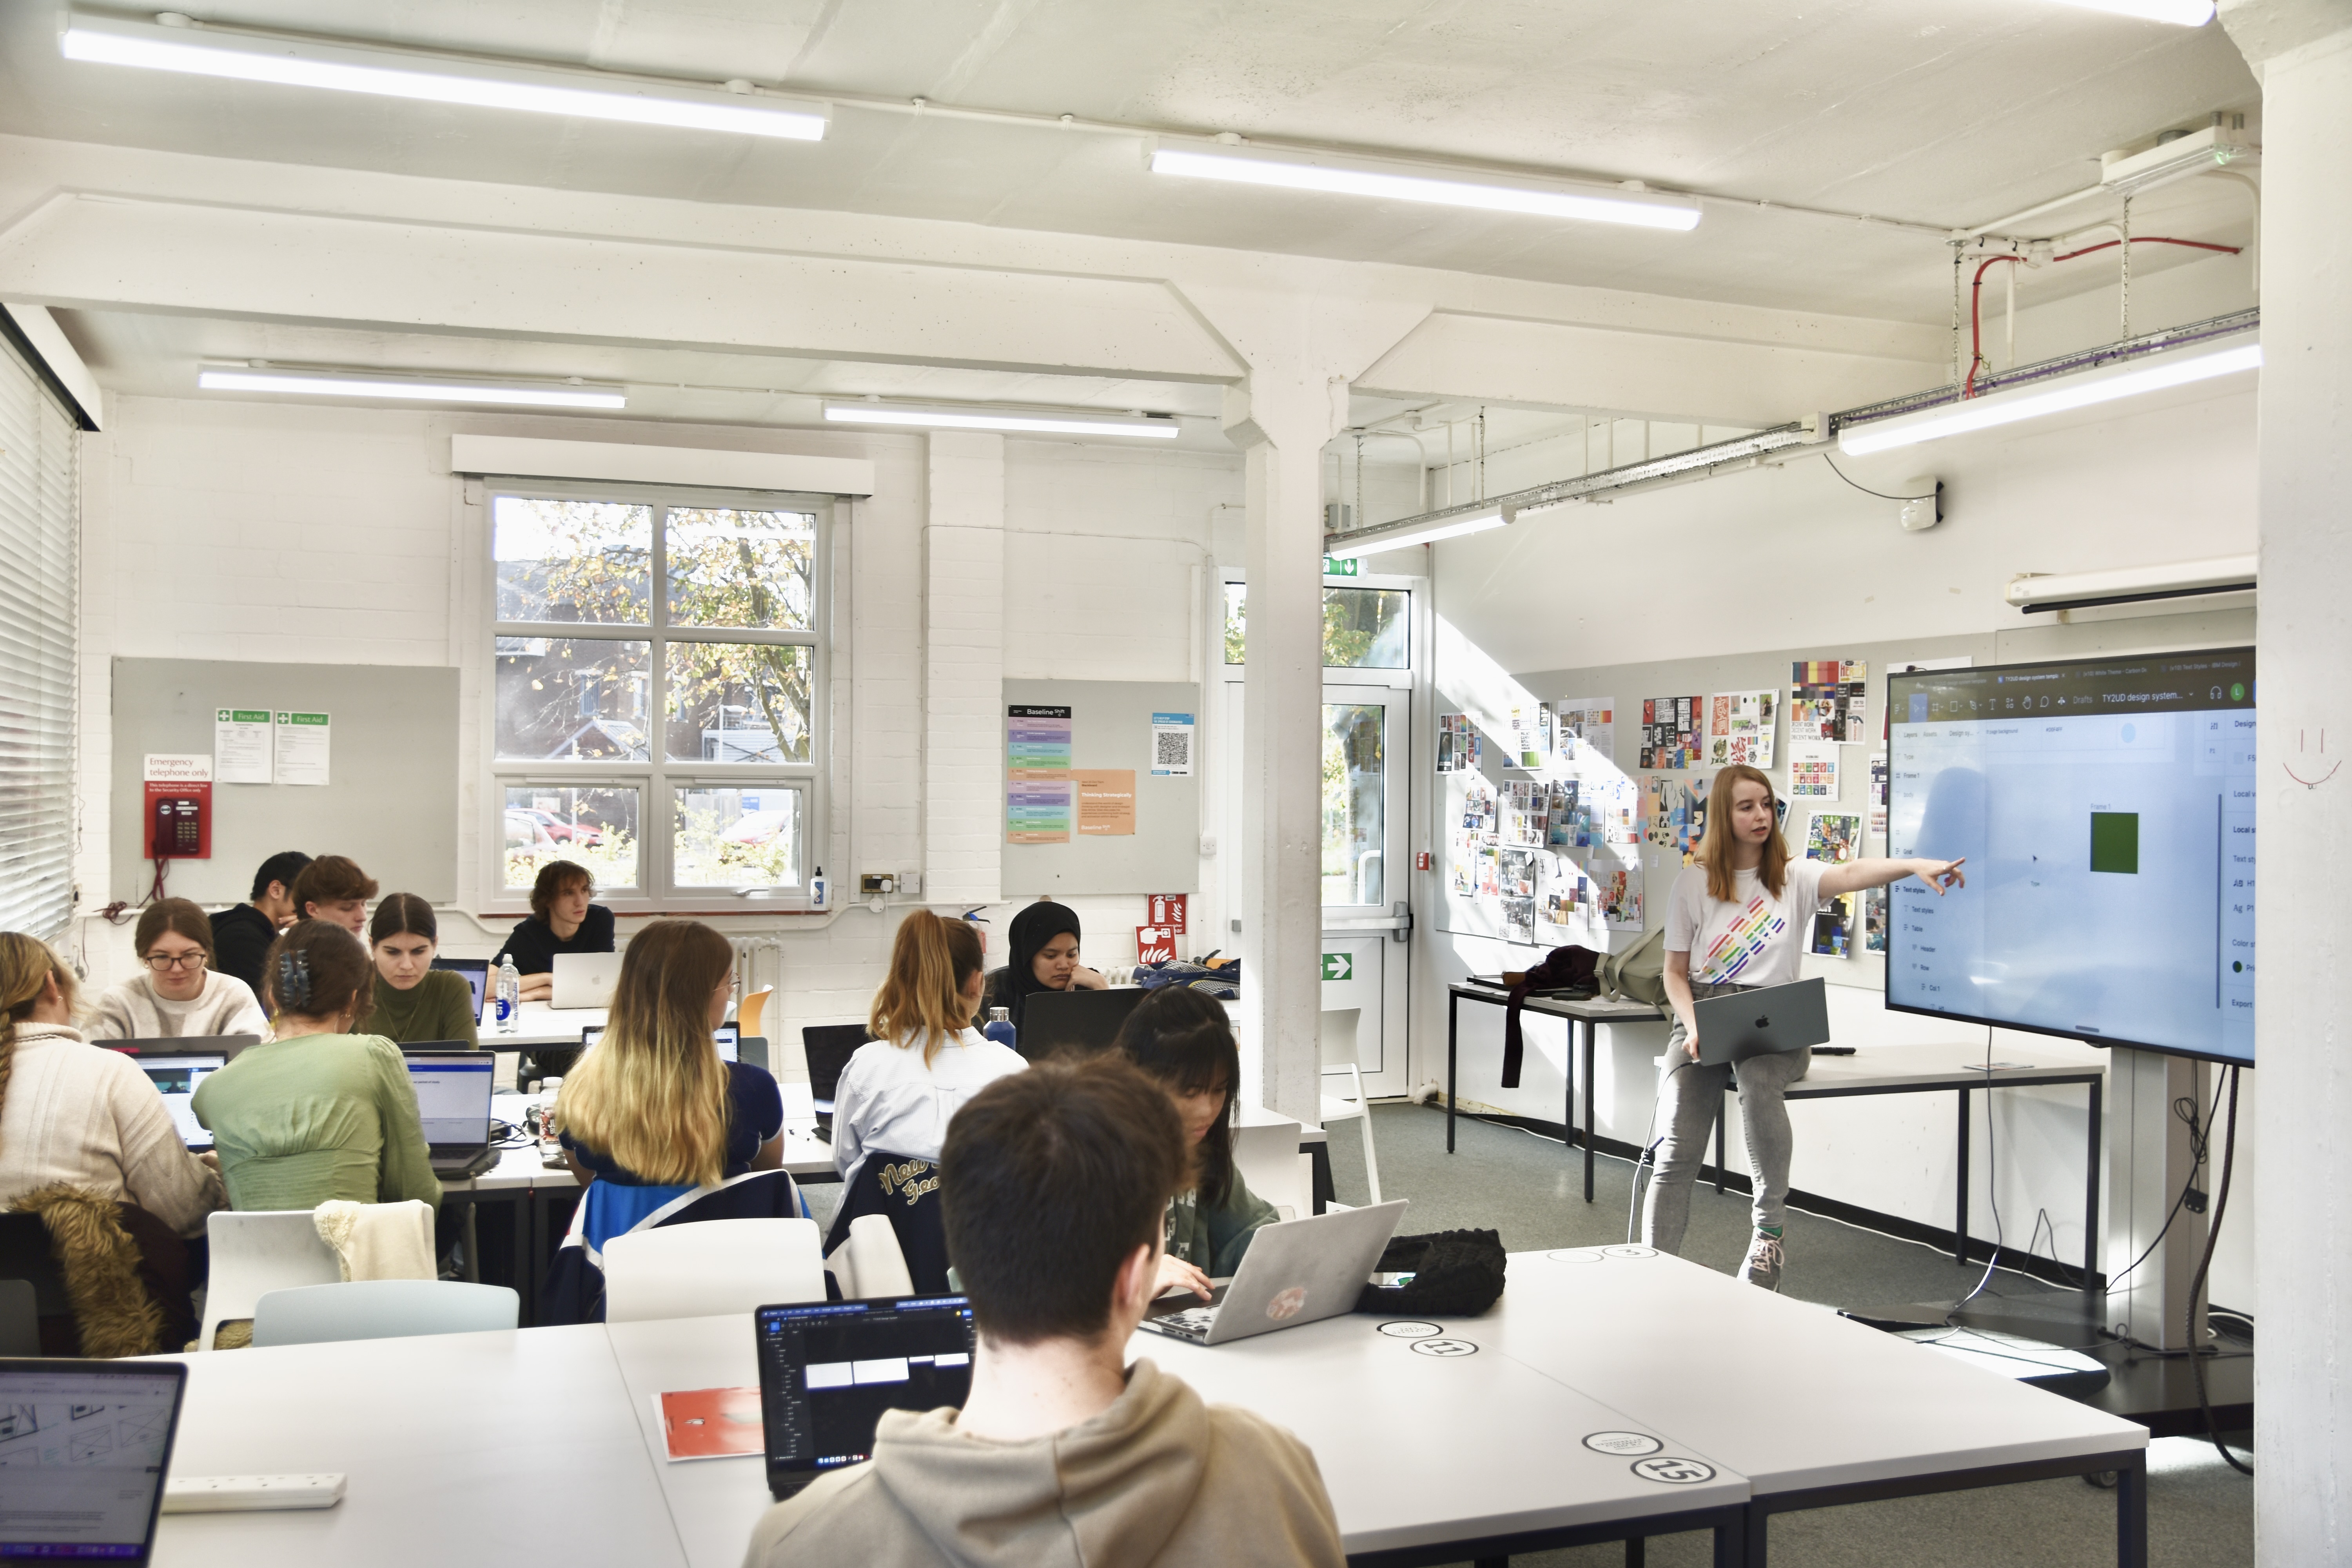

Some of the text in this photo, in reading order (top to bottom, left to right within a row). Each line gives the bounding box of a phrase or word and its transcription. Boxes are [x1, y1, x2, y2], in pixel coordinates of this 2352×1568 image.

[2073, 696, 2092, 704] Drafts
[2103, 691, 2183, 702] TY2UD design system...
[2234, 720, 2256, 729] Design
[150, 758, 193, 768] Emergency
[150, 768, 209, 778] telephone only
[2233, 904, 2243, 913] Ag
[2232, 999, 2253, 1008] Export
[878, 1159, 929, 1195] New
[1423, 1341, 1465, 1354] 11
[1595, 1438, 1645, 1446] LETTERSPACED
[1644, 1461, 1704, 1480] 15
